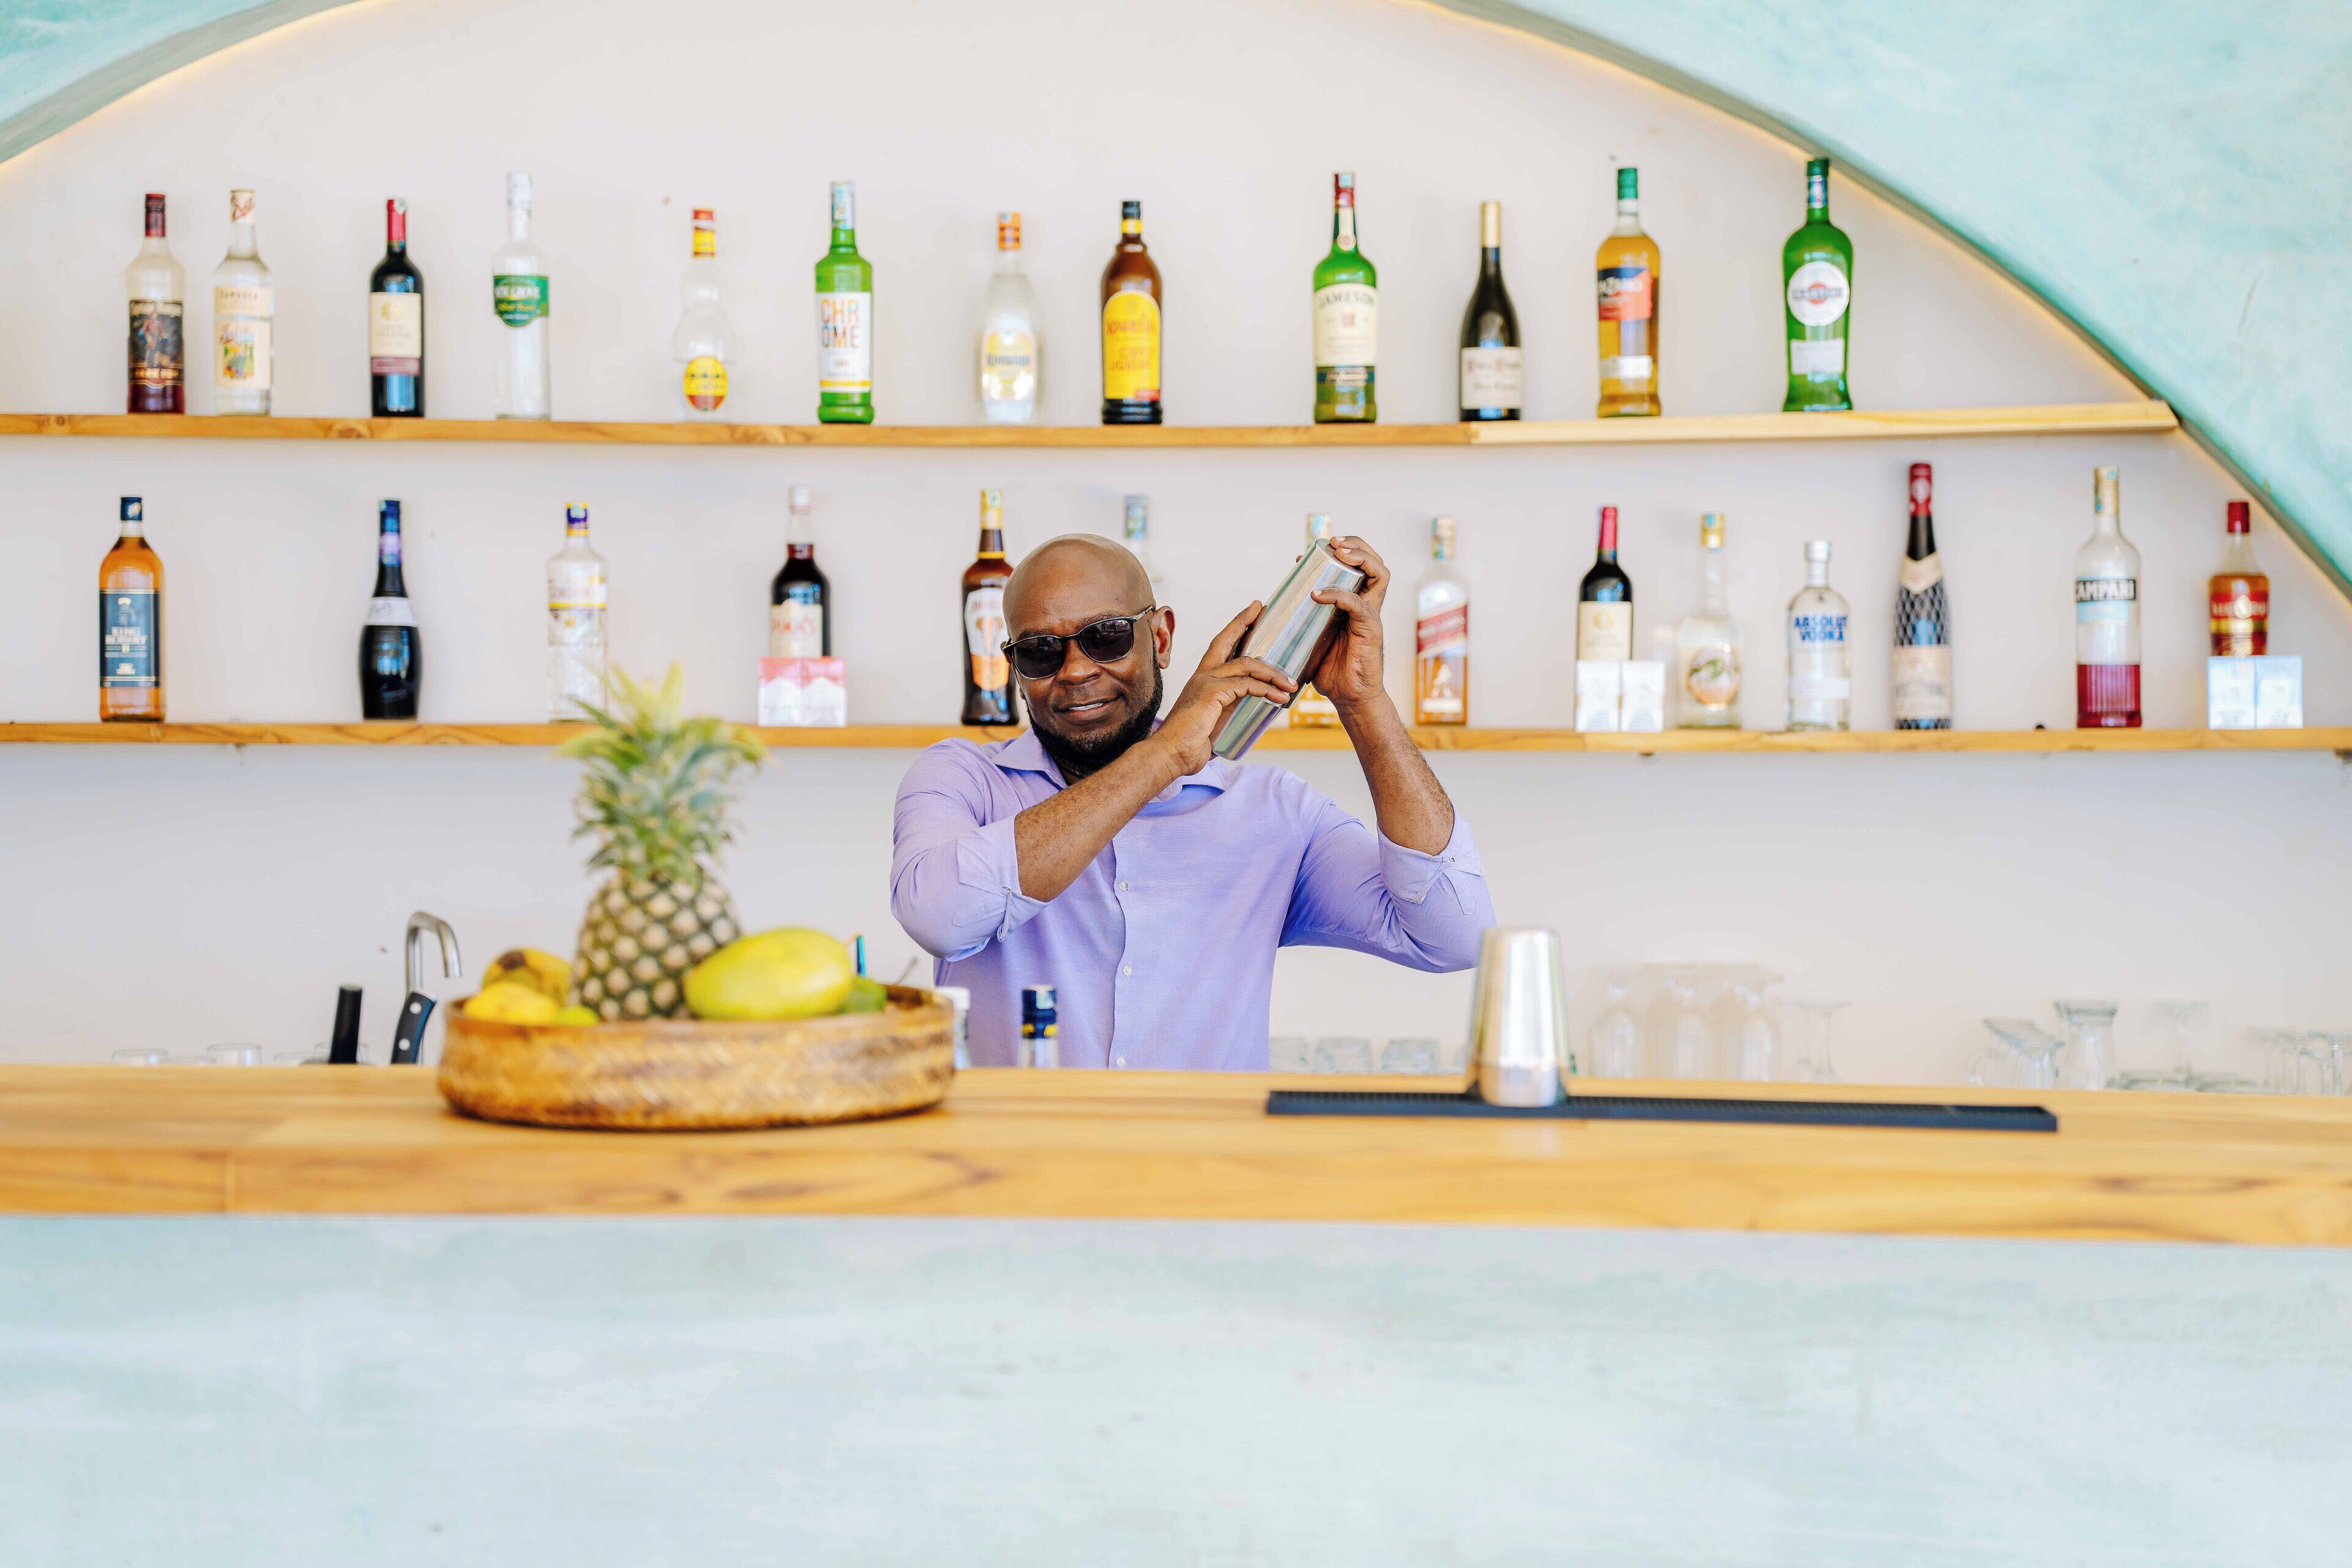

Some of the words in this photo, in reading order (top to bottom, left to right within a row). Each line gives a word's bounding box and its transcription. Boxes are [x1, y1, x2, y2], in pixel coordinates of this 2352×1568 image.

[1318, 288, 1375, 307] JAMESON
[820, 298, 859, 323] CHR
[821, 325, 861, 349] OME
[2077, 581, 2135, 600] AMPARI
[1795, 616, 1847, 627] ABSOLUT
[1800, 630, 1844, 641] VODKA
